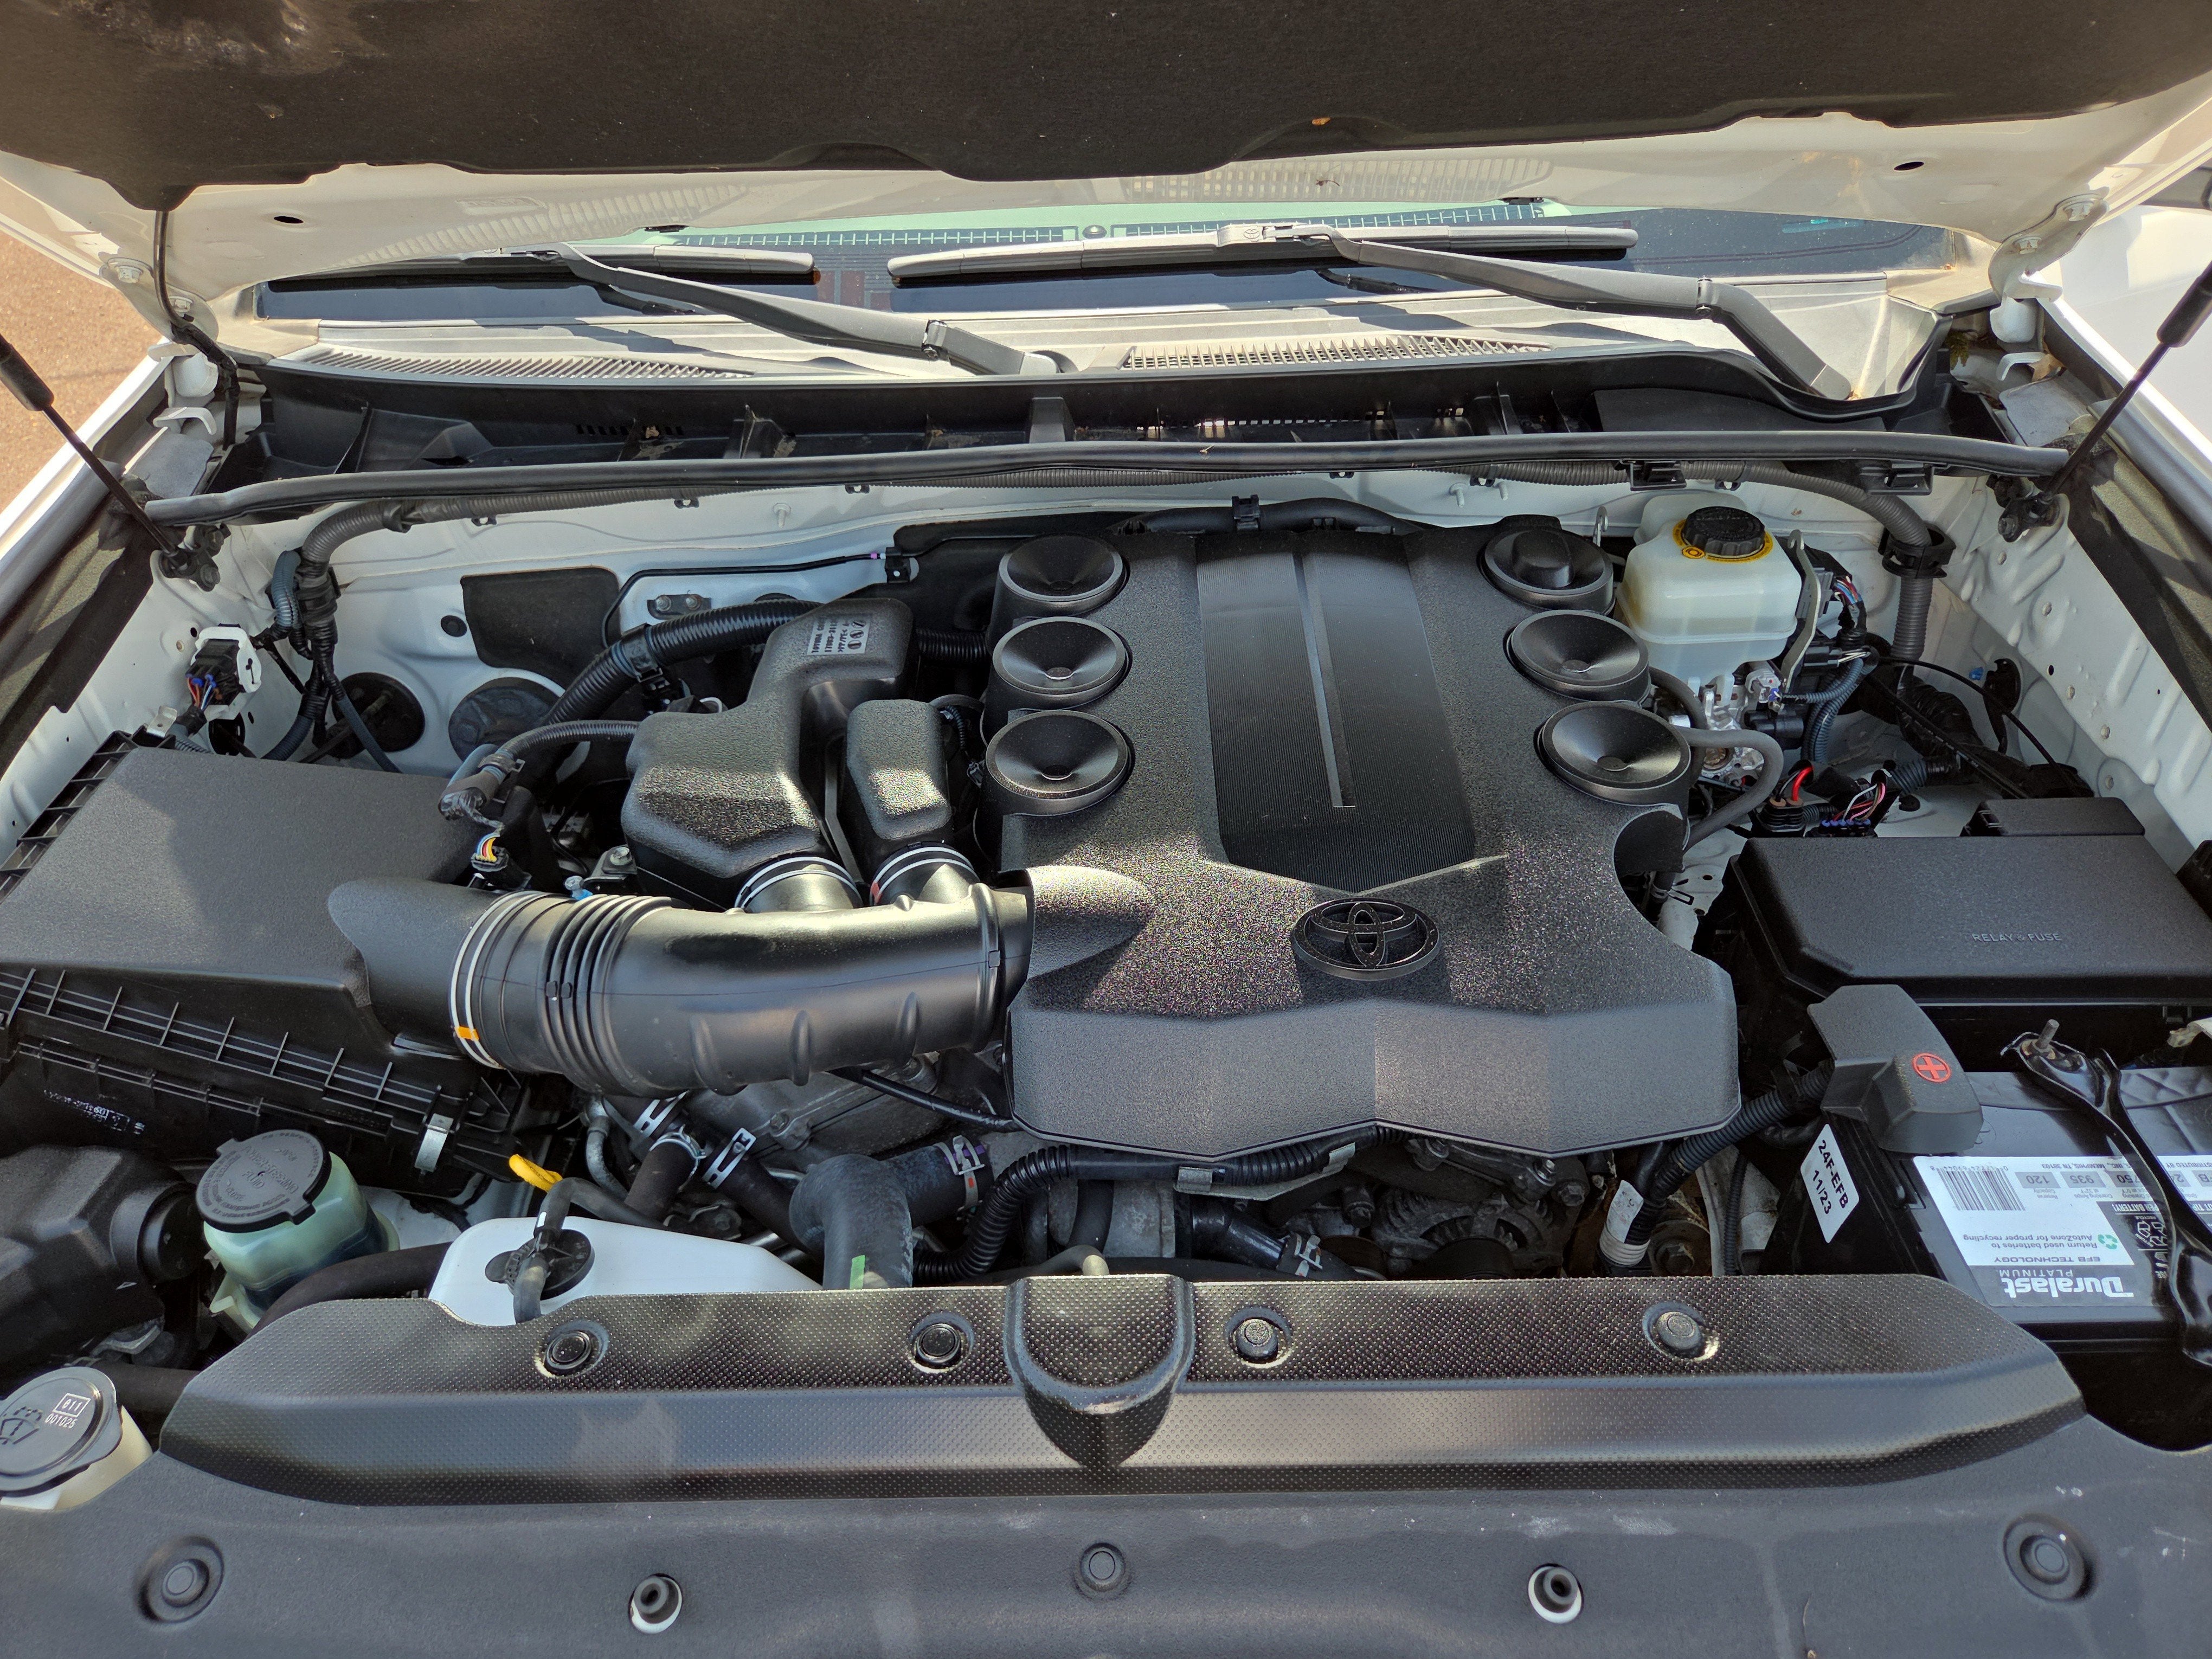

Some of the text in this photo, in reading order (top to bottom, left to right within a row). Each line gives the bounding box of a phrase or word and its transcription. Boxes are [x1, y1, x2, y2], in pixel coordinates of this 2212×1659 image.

[1972, 933, 2013, 942] RELAY
[2027, 933, 2062, 942] FUSE
[242, 1171, 266, 1189] FLUID
[264, 1161, 300, 1194] STEERING
[1818, 1140, 1849, 1208] 24F-EFB
[2026, 1175, 2050, 1184] 120
[2070, 1175, 2094, 1184] 935
[1813, 1170, 1832, 1214] 11/23
[2112, 1204, 2146, 1212] BATTERY!
[2001, 1277, 2134, 1298] Duralast
[44, 1413, 78, 1428] 001025
